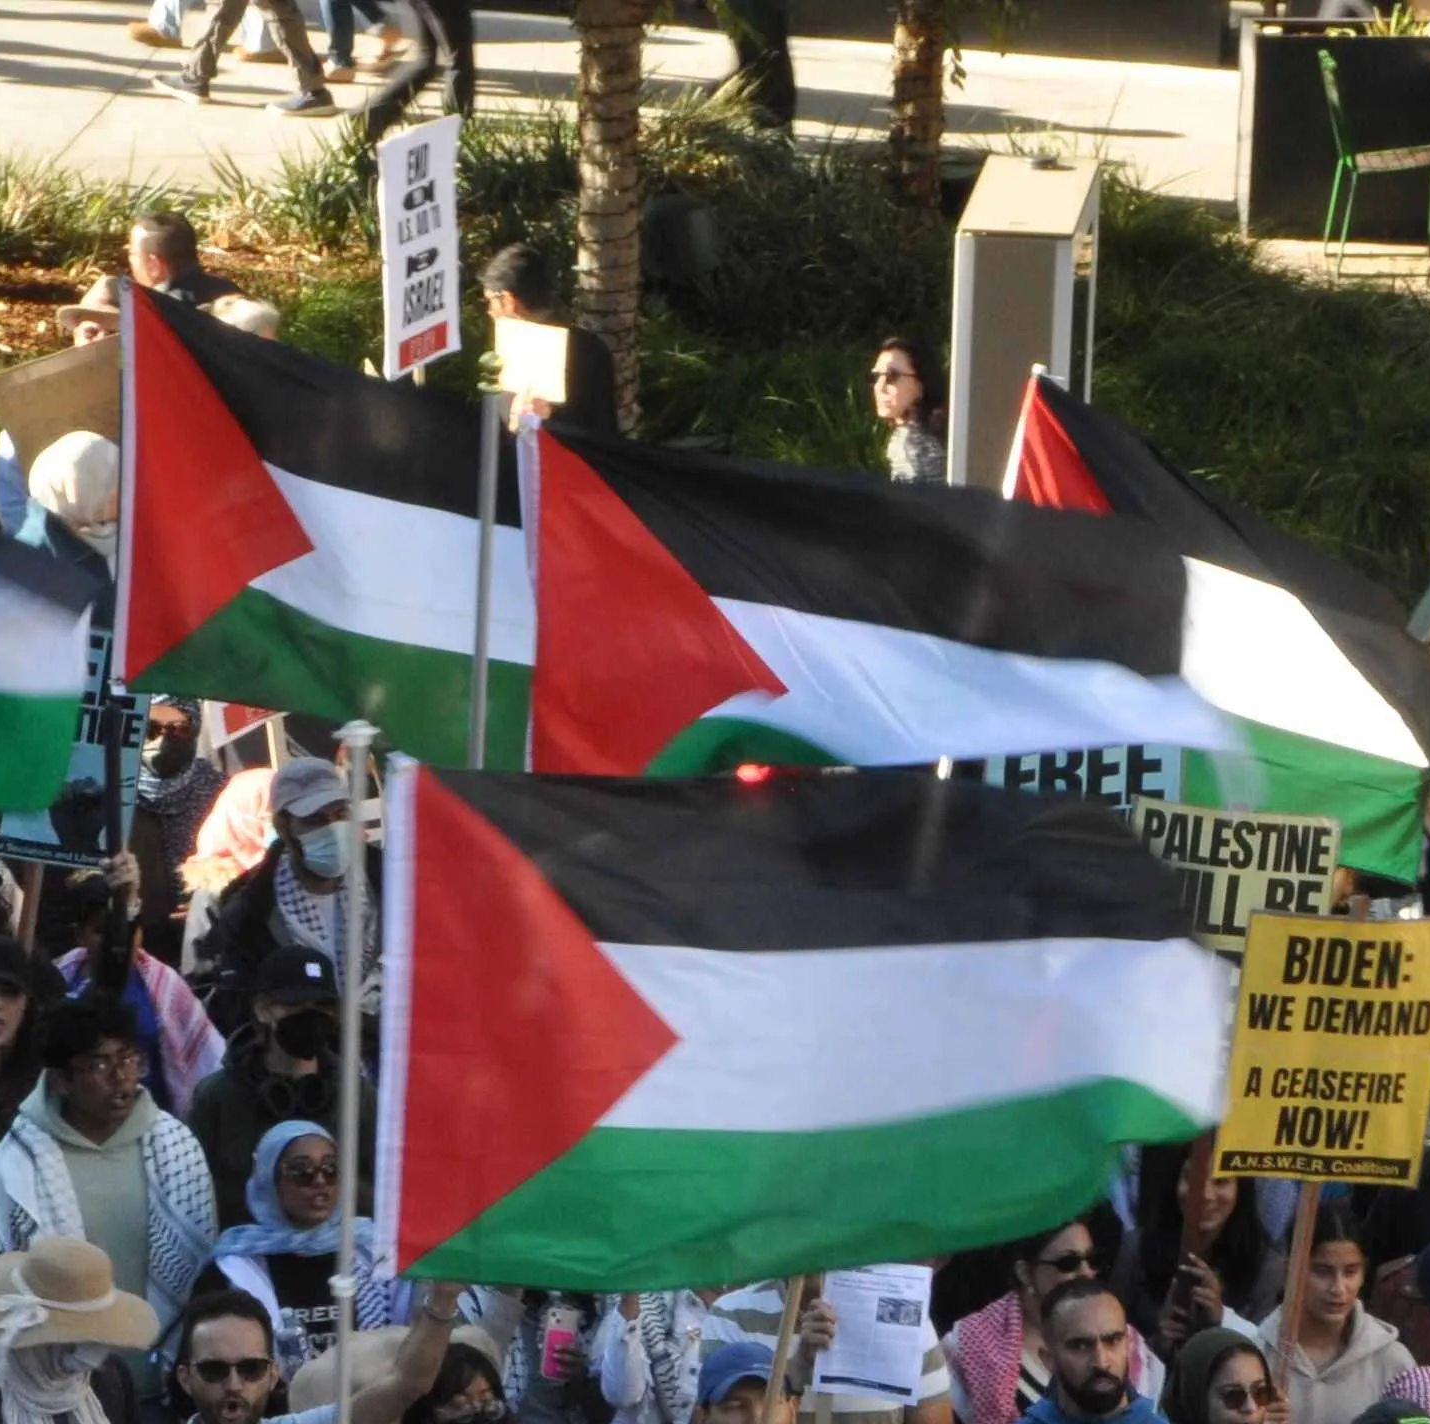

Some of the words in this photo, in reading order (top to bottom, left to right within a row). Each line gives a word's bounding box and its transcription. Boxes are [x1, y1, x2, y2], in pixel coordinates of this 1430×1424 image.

[1003, 744, 1167, 805] FREE
[1142, 807, 1333, 876] PALESTINE
[1176, 867, 1248, 937] ILL
[1264, 877, 1324, 915] BE
[1282, 935, 1415, 990] BIDEN:
[1247, 993, 1296, 1032] WE
[1244, 1066, 1263, 1098] A
[1271, 1067, 1407, 1105] CEASEFIRE
[1274, 1105, 1371, 1151] NOW!
[1229, 1152, 1327, 1174] A.N.S.W.E.R.
[1331, 1158, 1400, 1176] Coalition
[293, 1305, 340, 1324] REE
